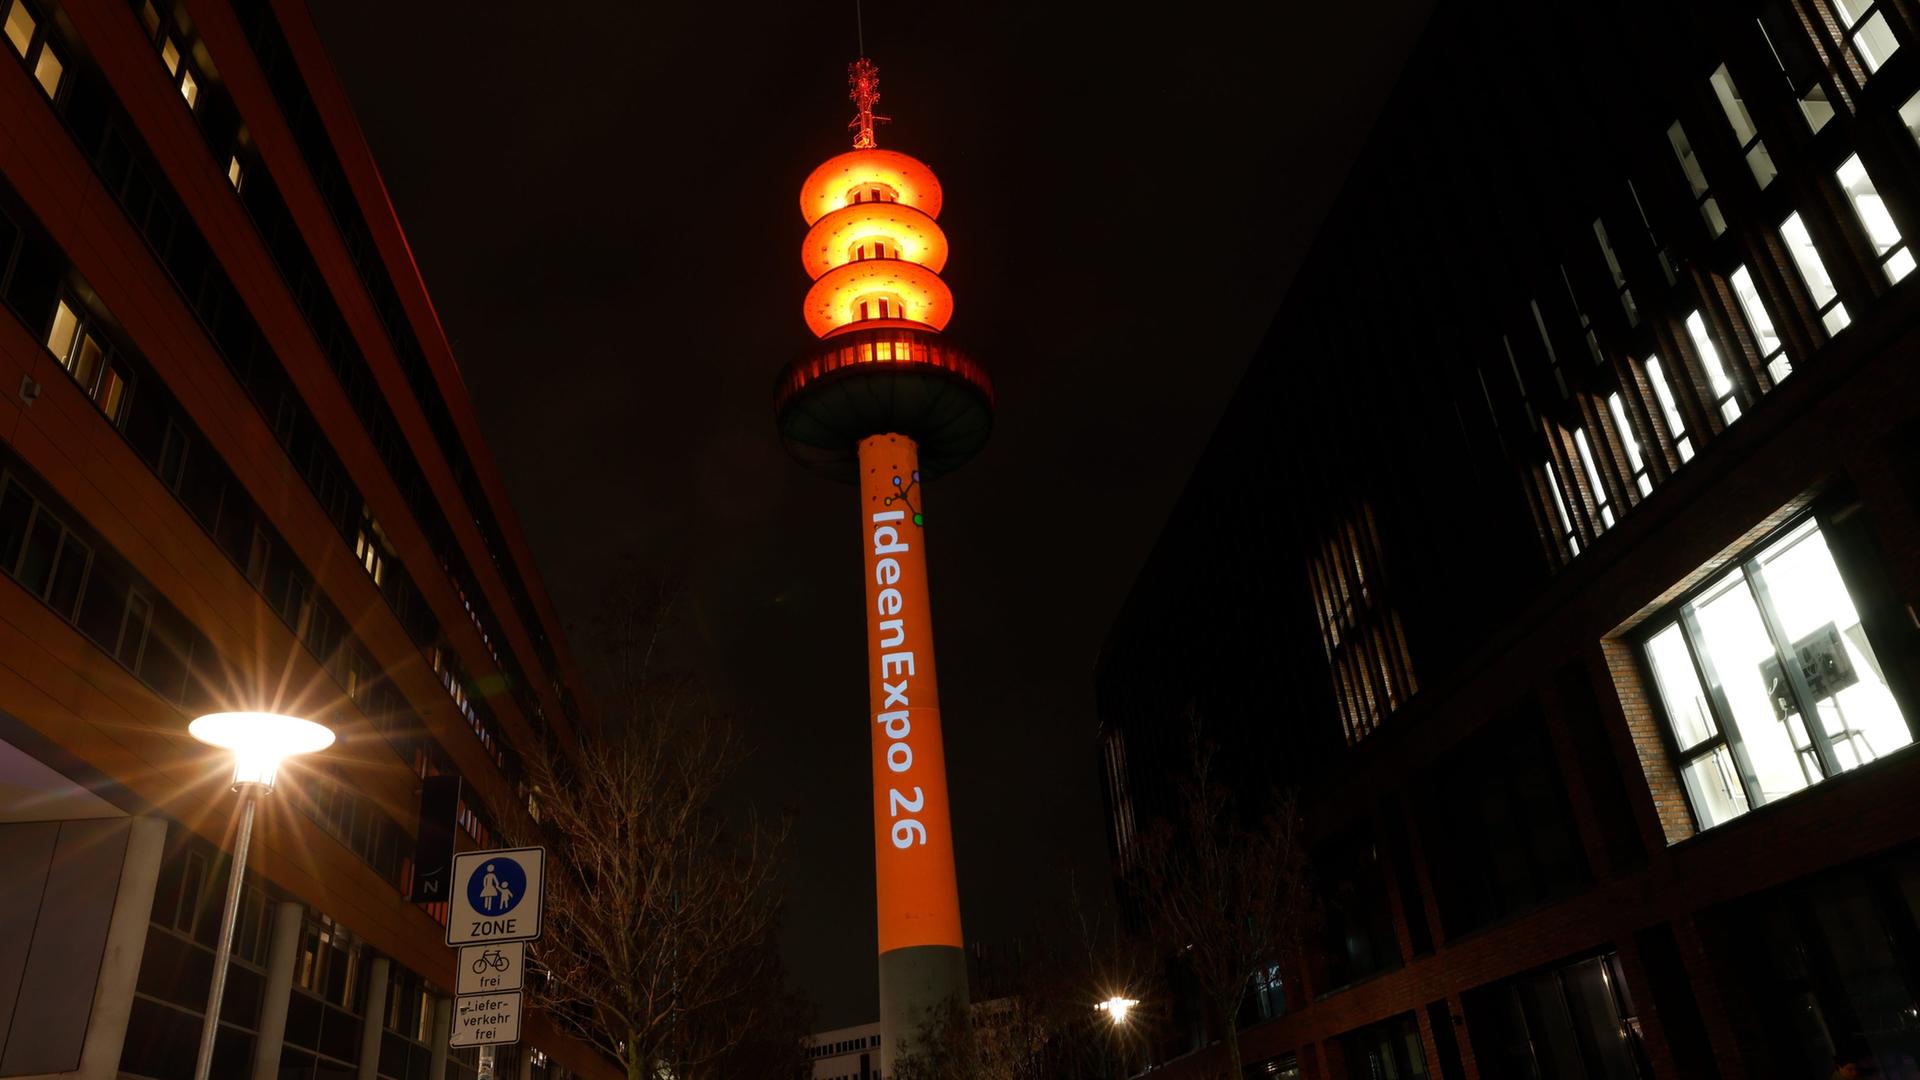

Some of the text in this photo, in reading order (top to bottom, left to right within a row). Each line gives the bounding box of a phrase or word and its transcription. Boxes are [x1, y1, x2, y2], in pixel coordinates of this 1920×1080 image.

[872, 510, 927, 849] IdeenExpo 26
[423, 880, 439, 895] N
[471, 919, 517, 937] ZONE
[480, 975, 501, 987] frei
[463, 1013, 510, 1026] verkehr
[475, 1027, 497, 1040] frei
